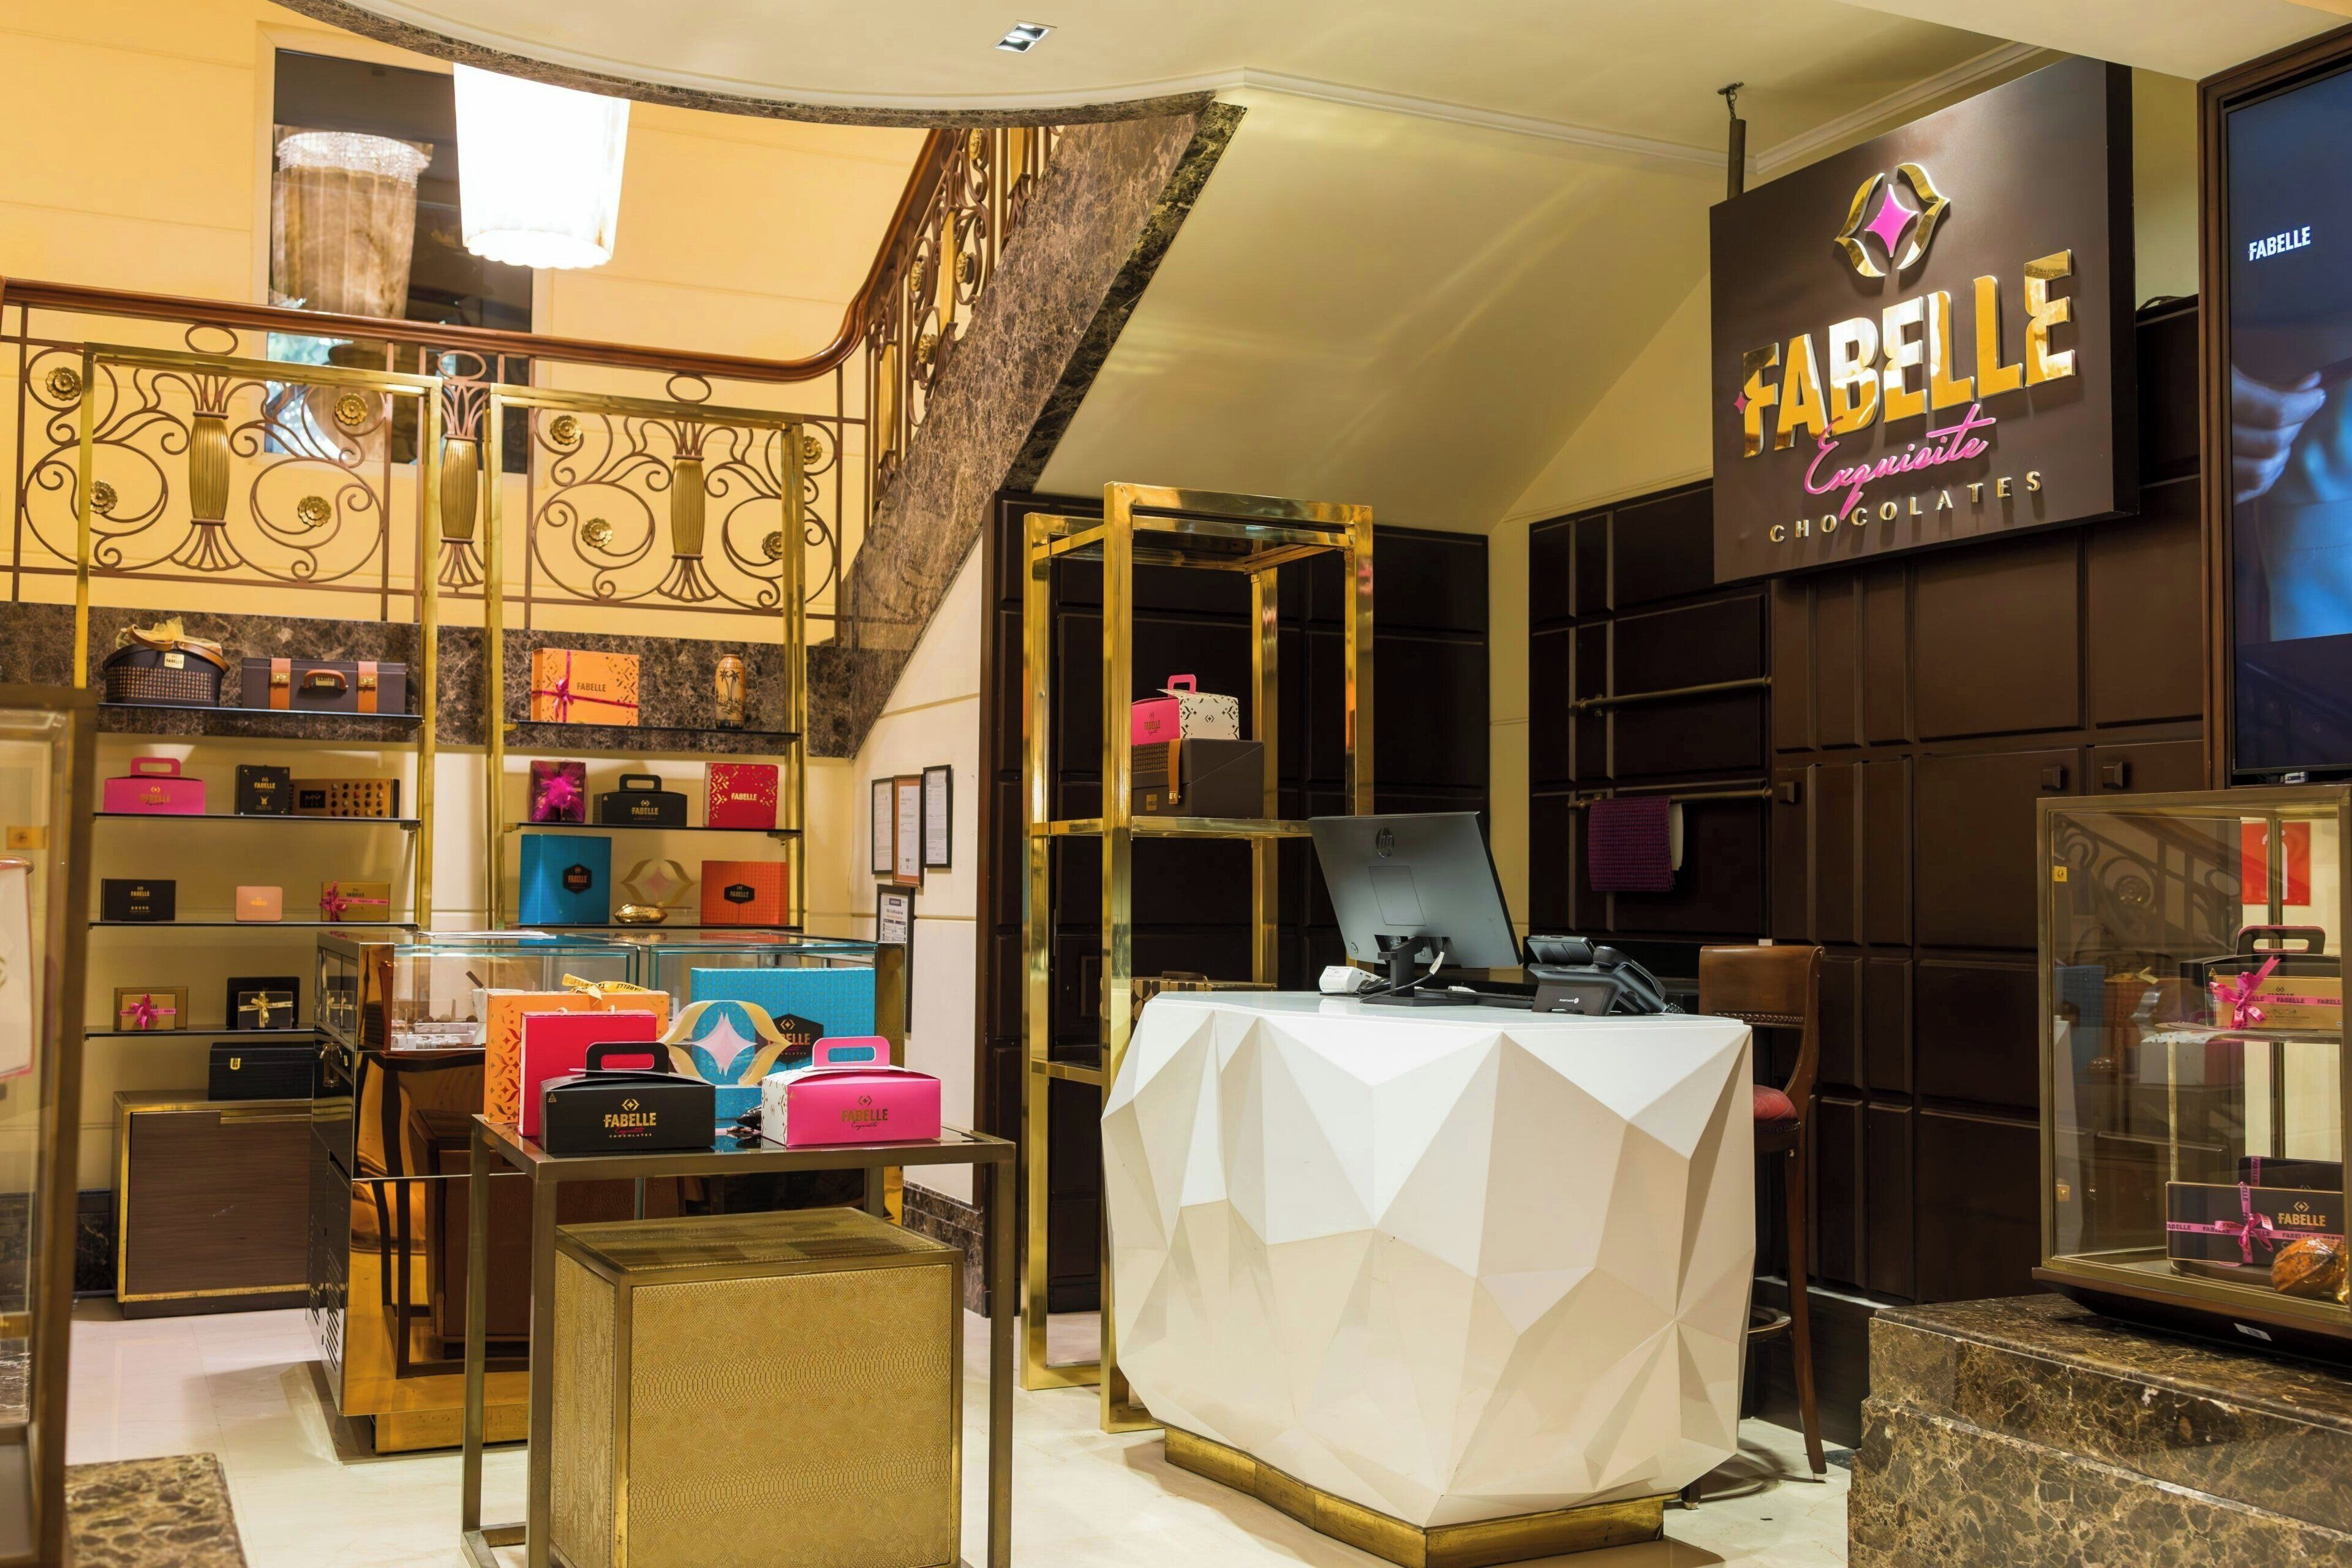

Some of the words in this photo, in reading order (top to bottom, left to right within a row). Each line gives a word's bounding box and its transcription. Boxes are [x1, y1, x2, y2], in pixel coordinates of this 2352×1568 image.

[2248, 225, 2311, 262] FABELLE
[1743, 249, 2076, 458] FABELLE
[1804, 403, 1997, 521] Exquisite
[1769, 470, 2042, 543] CHOCOLATES
[576, 682, 606, 692] FABELLE
[731, 792, 758, 801] FABELLE
[631, 807, 658, 815] FABELLE
[567, 875, 587, 883] FABELLE
[604, 1112, 657, 1128] FABELLE
[841, 1108, 888, 1122] FABELLE
[2278, 1212, 2326, 1227] FABELLE
